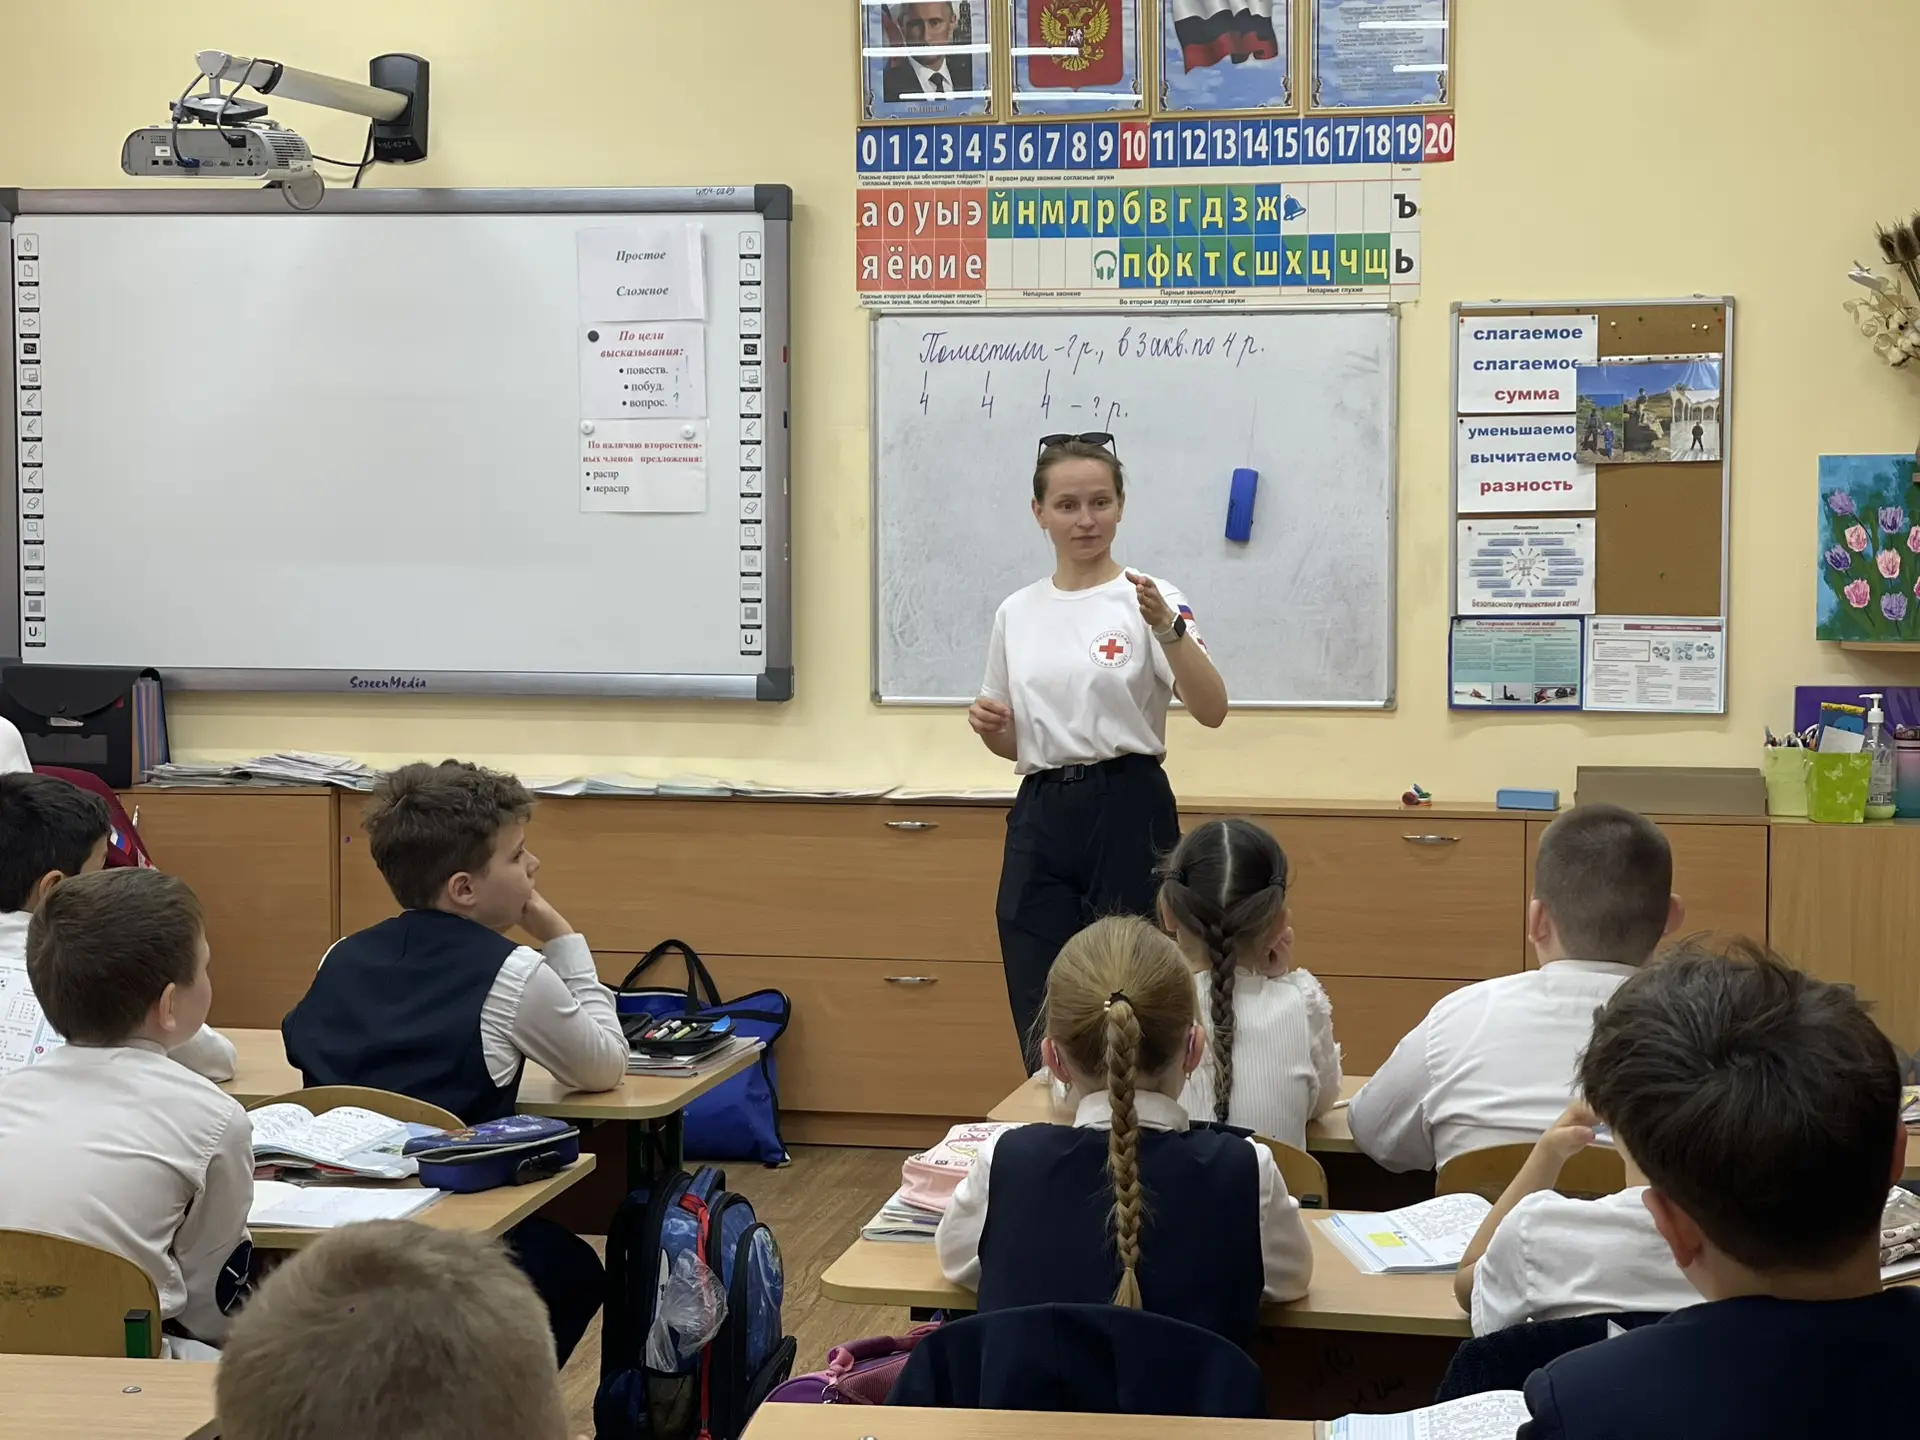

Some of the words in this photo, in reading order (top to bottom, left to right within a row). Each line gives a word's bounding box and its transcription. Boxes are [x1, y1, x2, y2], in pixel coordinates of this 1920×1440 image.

[862, 135, 877, 166] 0
[890, 134, 900, 165] 1
[914, 134, 928, 164] 2
[940, 133, 954, 164] 3
[965, 133, 982, 164] 4
[993, 133, 1007, 164] 5
[1019, 132, 1034, 163] 6
[1046, 131, 1061, 163] 7
[1072, 131, 1087, 162] 8
[1098, 130, 1114, 162] 9
[1122, 130, 1147, 161] 10
[1152, 129, 1174, 161] 11
[1182, 129, 1207, 160] 12
[1212, 128, 1237, 159] 13
[1243, 127, 1269, 159] 14
[1273, 127, 1298, 158] 15
[1304, 126, 1330, 157] 16
[1335, 125, 1360, 157] 17
[1365, 124, 1391, 156] 18
[1395, 123, 1422, 155] 19
[1425, 122, 1452, 155] 20
[861, 202, 879, 226] а
[888, 202, 904, 226] о
[914, 201, 930, 235] у
[937, 201, 959, 226] ы
[966, 201, 982, 226] э
[992, 191, 1009, 225] й
[1018, 200, 1035, 225] н
[1042, 200, 1064, 225] м
[1071, 200, 1089, 225] л
[1097, 199, 1115, 233] р
[1123, 189, 1141, 225] б
[1150, 198, 1167, 224] в
[1178, 198, 1192, 222] г
[1202, 197, 1223, 229] д
[1232, 196, 1248, 222] з
[1256, 196, 1278, 221] ж
[616, 250, 667, 263] Простое
[862, 255, 879, 280] я
[887, 245, 904, 280] ё
[910, 255, 933, 280] ю
[939, 254, 956, 279] и
[966, 254, 982, 279] е
[1123, 253, 1140, 278] п
[1147, 244, 1170, 287] ф
[1177, 252, 1193, 277] к
[1204, 252, 1220, 276] т
[1232, 251, 1246, 276] с
[1255, 251, 1278, 275] ш
[1285, 250, 1302, 275] х
[1312, 250, 1330, 281] ц
[1340, 249, 1357, 274] ч
[1365, 249, 1388, 279] щ
[616, 286, 669, 297] Сложное
[1022, 290, 1055, 298] Непарные
[1307, 287, 1340, 295] Непарные
[1341, 286, 1364, 294] глухие
[619, 331, 635, 341] По
[638, 331, 664, 342] цели
[1473, 328, 1583, 340] слагаемое
[919, 331, 1048, 363] Поместили
[600, 348, 684, 358] высказывания:
[626, 366, 669, 375] повеств.
[631, 381, 665, 393] побуд.
[1494, 389, 1559, 404] сумма
[629, 399, 668, 409] вопрос.
[1468, 425, 1576, 439] уменьшаемо
[588, 441, 600, 449] По
[602, 441, 642, 449] наличию
[644, 441, 702, 451] второстепен-
[640, 456, 703, 464] предложения:
[593, 470, 619, 480] распр
[593, 485, 630, 495] нераспр
[1480, 480, 1573, 496] разность
[350, 675, 426, 688] ScreenMedia
